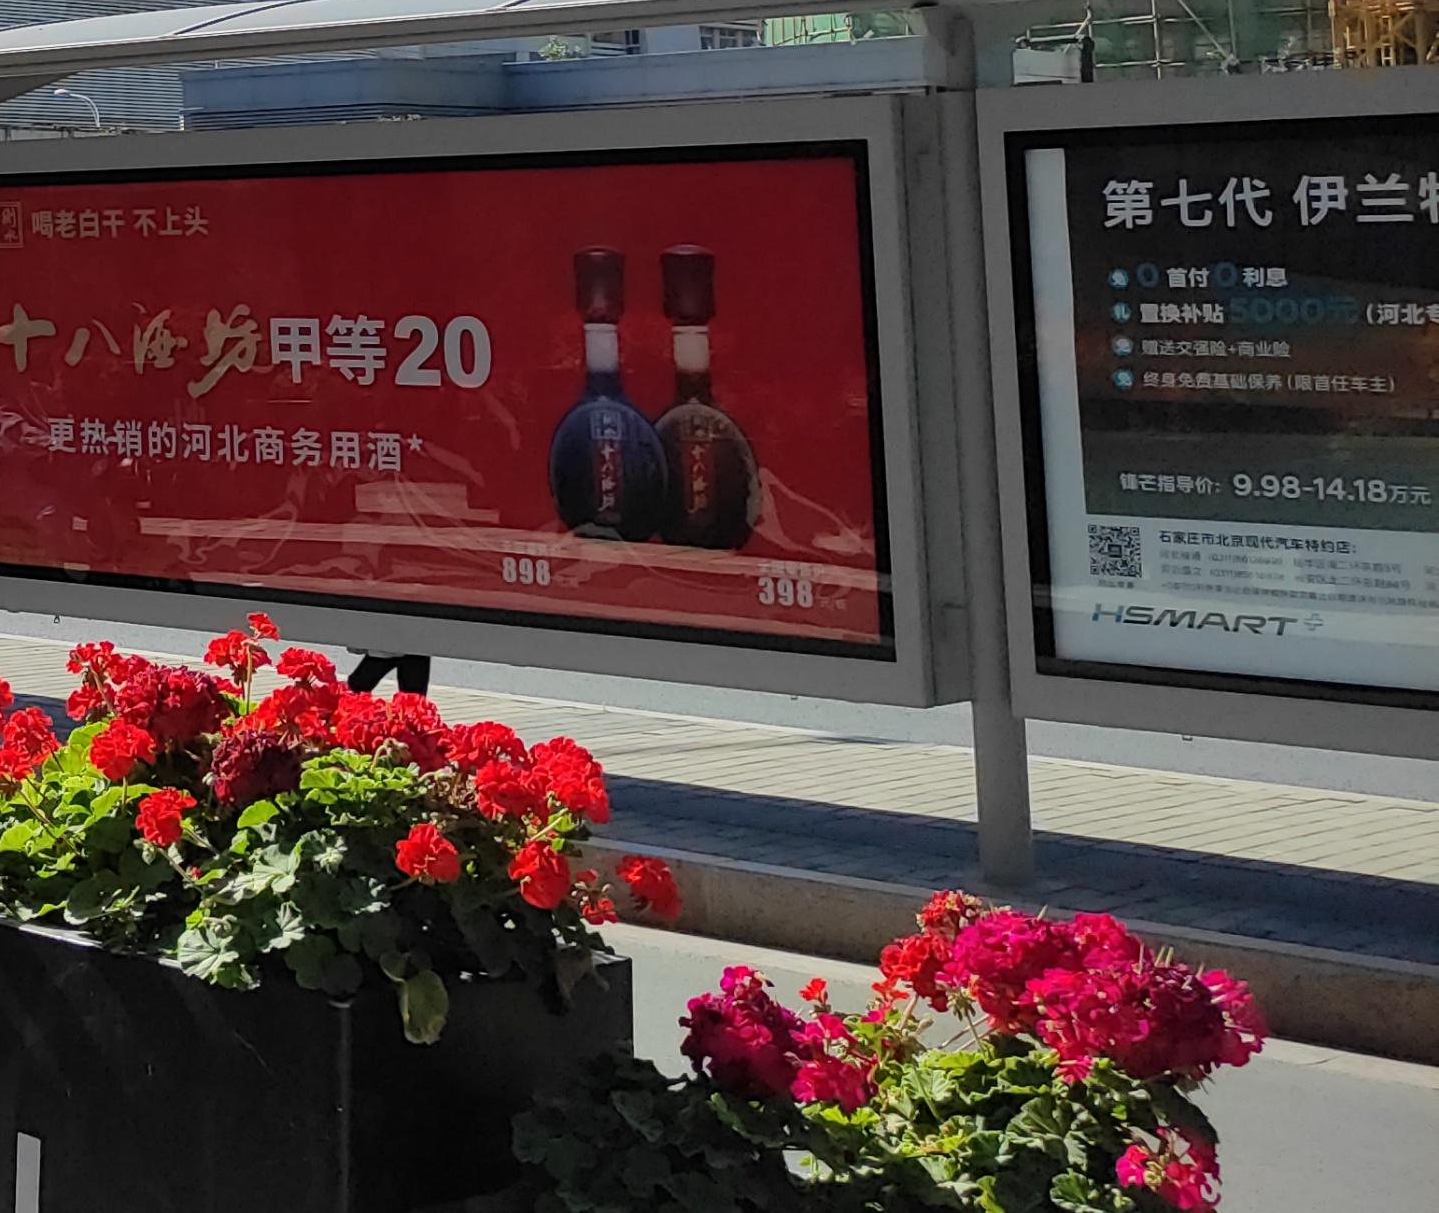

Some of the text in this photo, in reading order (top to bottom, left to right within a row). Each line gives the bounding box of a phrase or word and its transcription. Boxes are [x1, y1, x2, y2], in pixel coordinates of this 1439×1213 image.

[1102, 177, 1273, 229] 第七代
[32, 206, 209, 238] 喝老白干 不上头
[1232, 473, 1432, 506] 9.98-14.18万元
[502, 556, 551, 586] 898
[758, 576, 814, 608] 398
